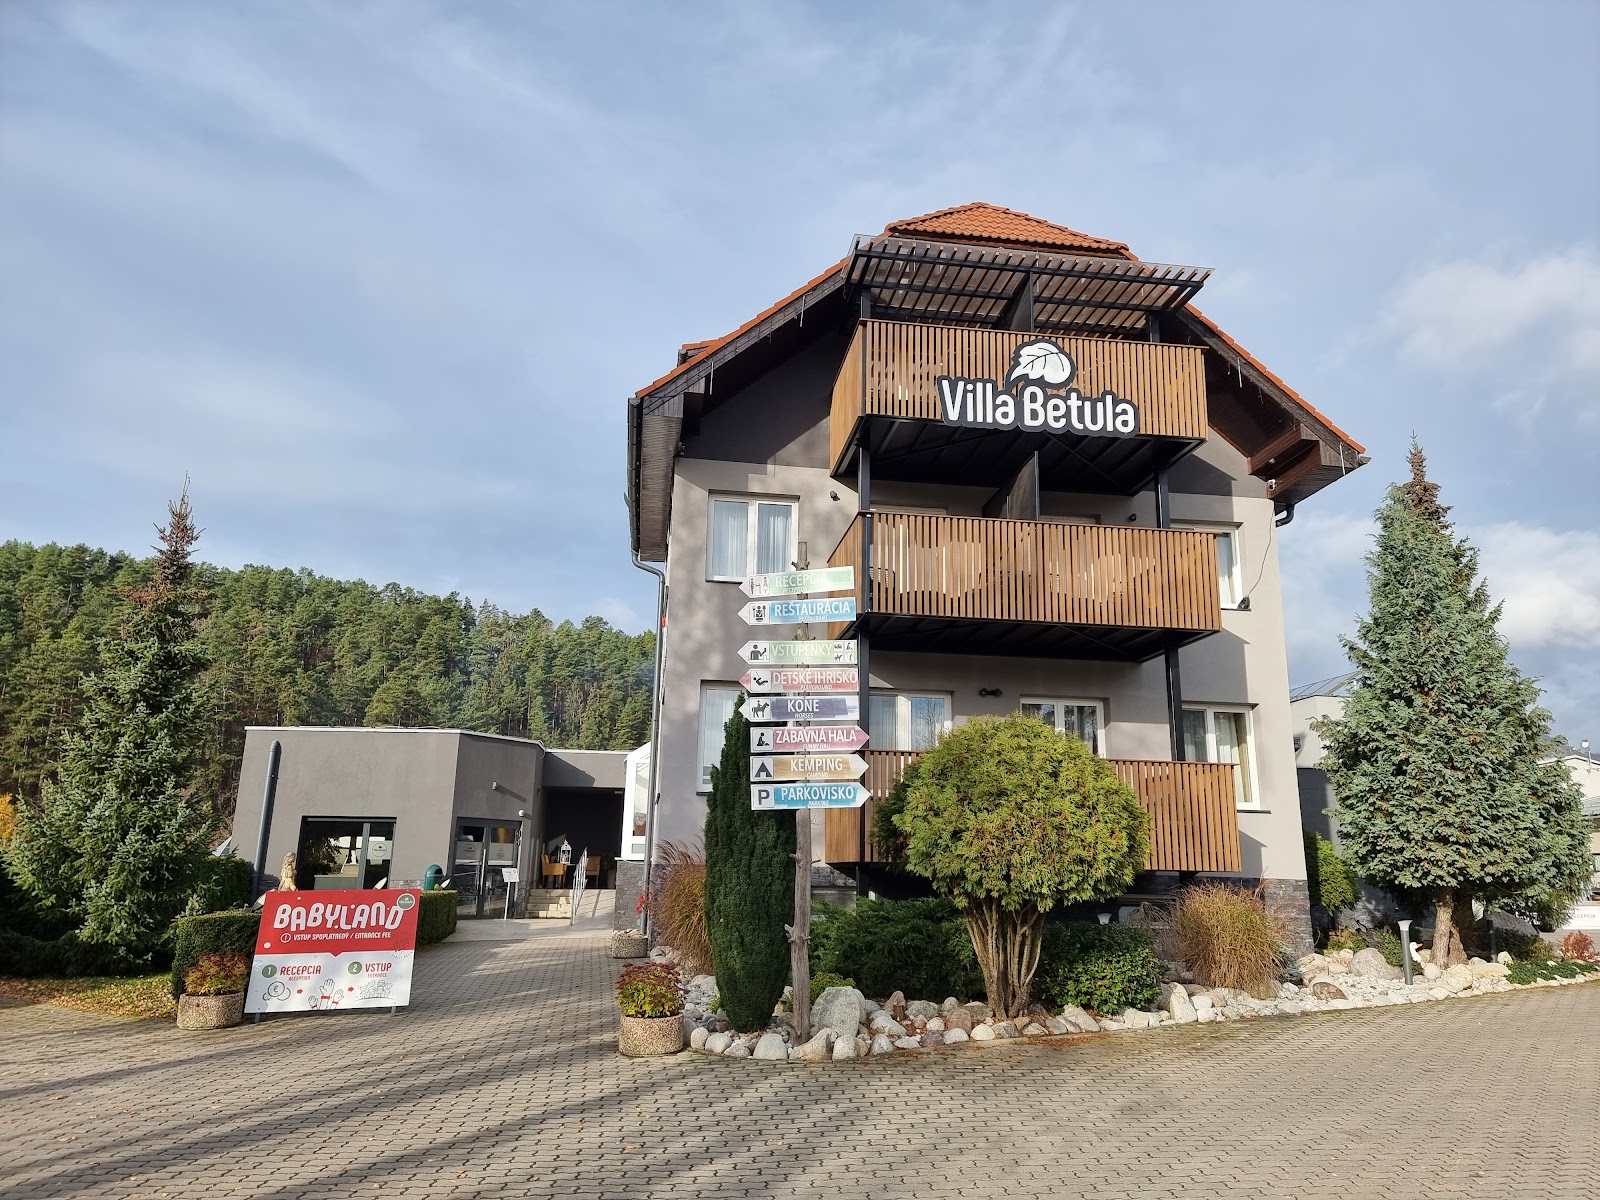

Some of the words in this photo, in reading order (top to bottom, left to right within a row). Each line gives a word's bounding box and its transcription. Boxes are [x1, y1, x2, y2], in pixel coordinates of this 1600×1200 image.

[941, 380, 1015, 424] Villa
[1023, 386, 1135, 433] Betula
[776, 572, 827, 588] RECEPCIA
[774, 600, 851, 616] REŠTAURÁCIA
[771, 643, 833, 656] VSTUPENKY
[772, 669, 812, 684] DETSKÉ
[814, 671, 857, 684] IHRISKO
[787, 700, 820, 712] KONE
[776, 727, 827, 743] ZÁBAVNÁ
[828, 729, 857, 742] HALA
[790, 758, 843, 772] KEMPING
[757, 789, 770, 805] P
[781, 786, 854, 800] PARKOVISKO
[273, 902, 404, 931] BABYLAND
[280, 965, 321, 976] RECEPCIA
[352, 962, 358, 971] 2
[365, 962, 392, 973] VSTUP
